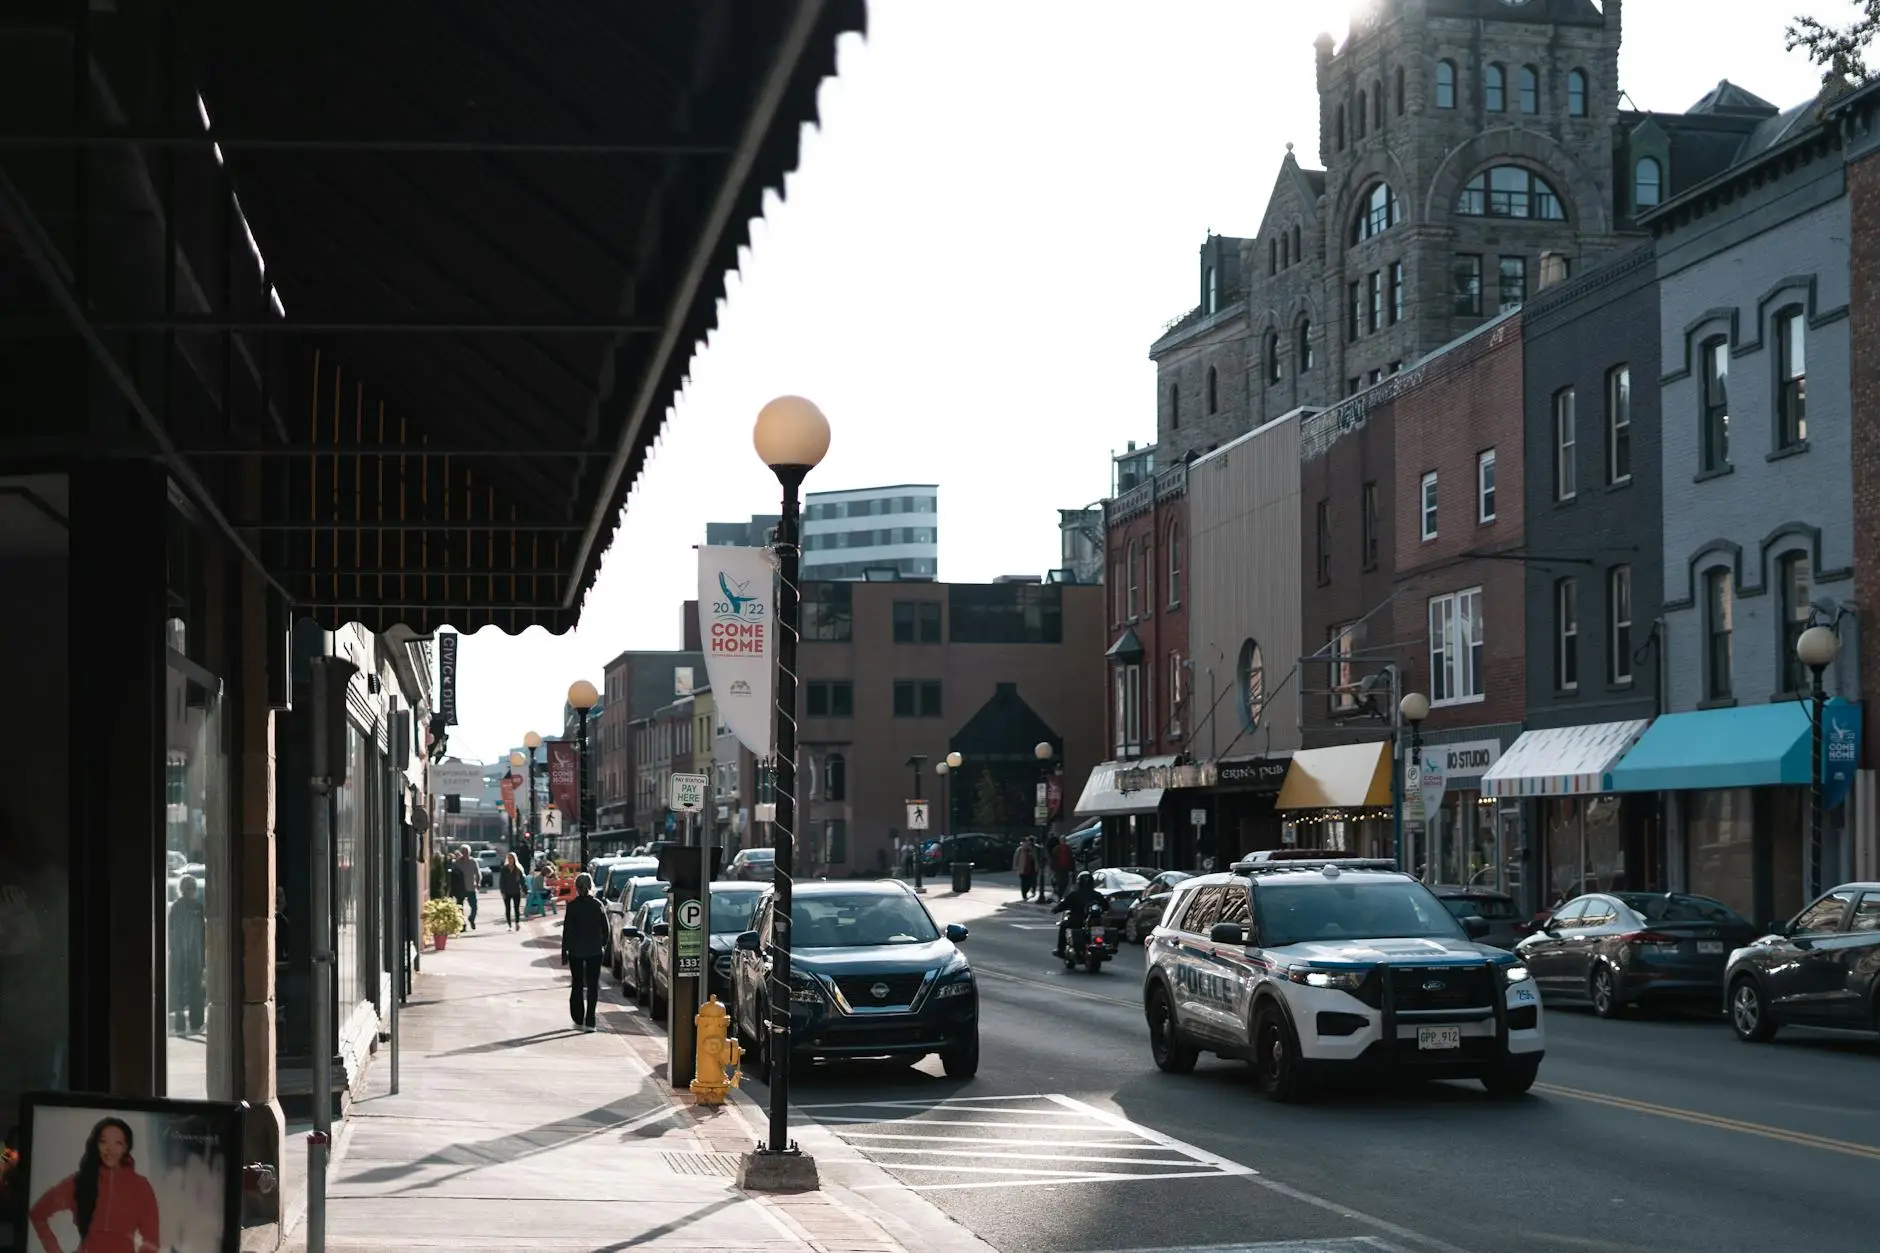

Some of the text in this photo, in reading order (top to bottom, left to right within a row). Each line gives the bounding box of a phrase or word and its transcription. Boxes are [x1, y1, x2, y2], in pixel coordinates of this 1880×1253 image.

[713, 602, 764, 615] 20 22
[711, 623, 764, 638] COME
[711, 638, 764, 653] HOME
[443, 637, 455, 675] CIVIC
[1459, 748, 1490, 769] STUDIO
[1829, 751, 1855, 759] HOME
[681, 784, 698, 793] PAY
[677, 793, 700, 802] HERE
[688, 907, 699, 923] P
[1176, 963, 1234, 1004] POLICE
[1420, 1031, 1458, 1043] GPP 912
